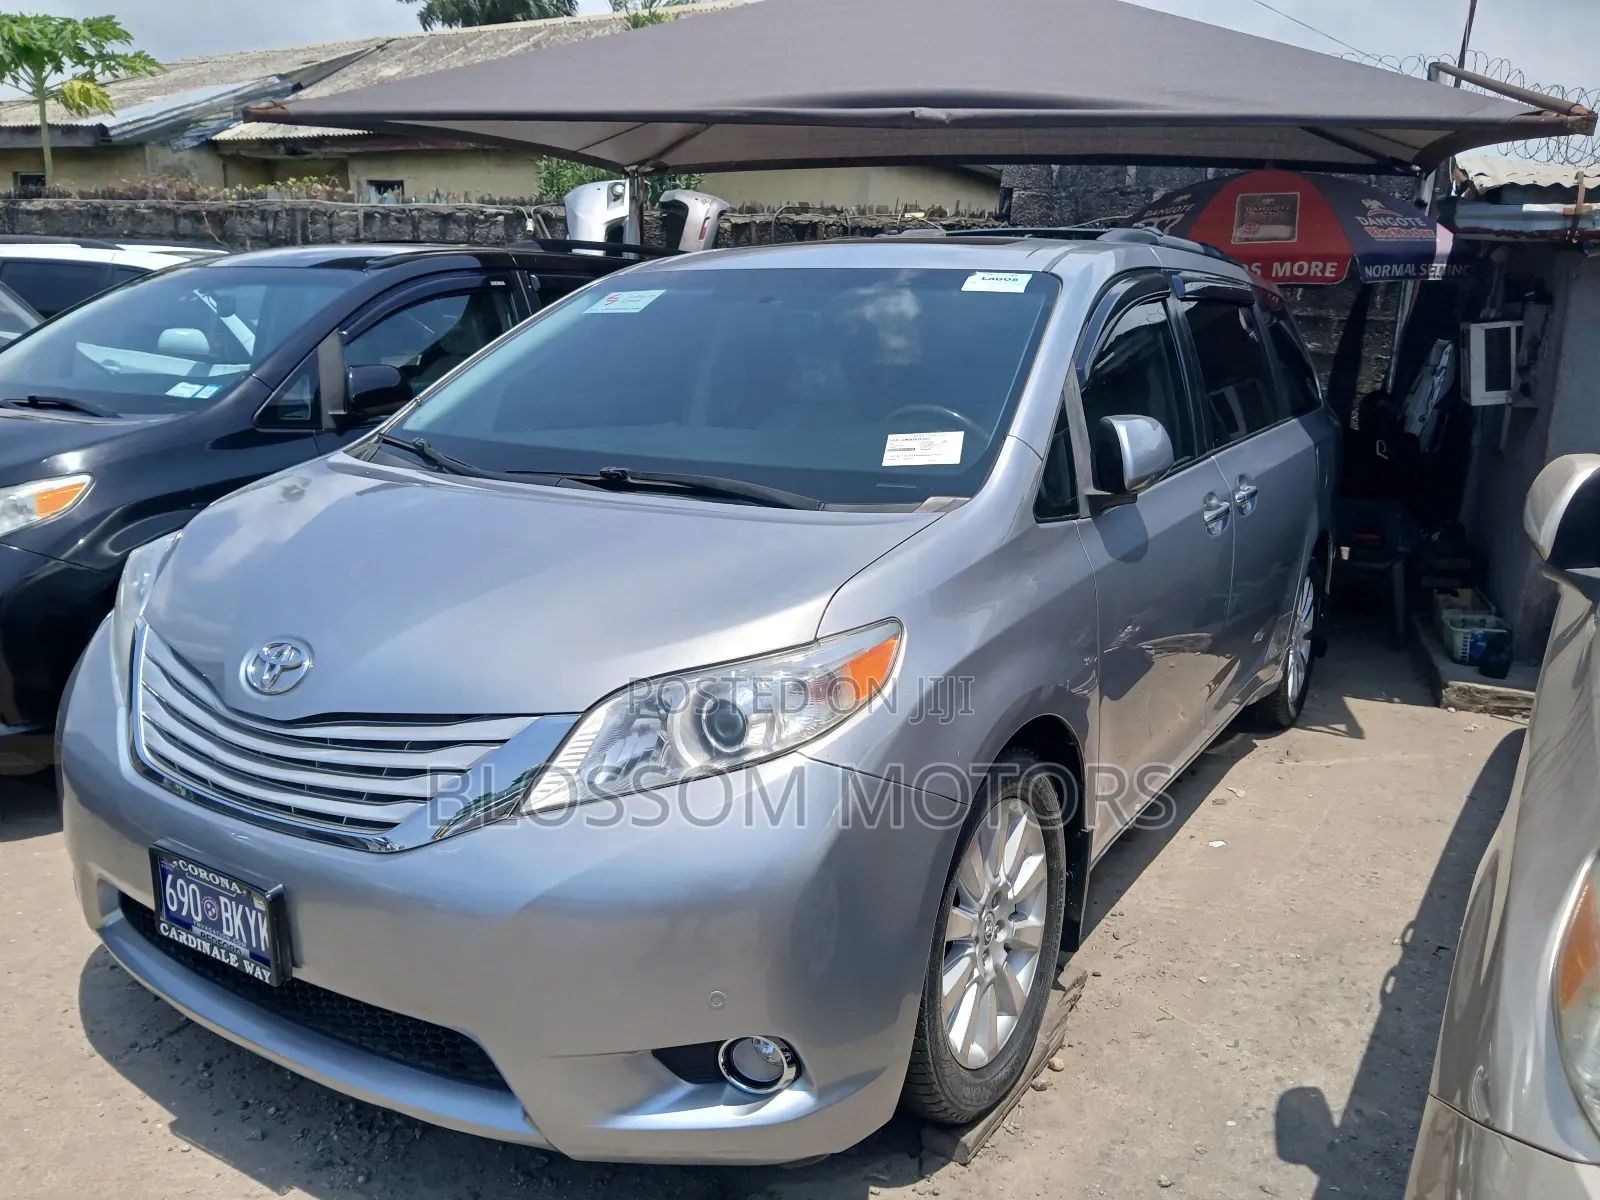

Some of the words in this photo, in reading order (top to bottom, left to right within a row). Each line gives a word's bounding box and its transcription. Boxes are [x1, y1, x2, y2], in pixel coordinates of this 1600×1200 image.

[1143, 203, 1195, 217] DANGOTE
[1355, 216, 1428, 227] DANGOTE
[1271, 261, 1338, 277] MORE
[1364, 263, 1416, 278] NORMAL
[178, 859, 243, 895] CORONA
[166, 874, 202, 922] 690
[220, 896, 270, 952] BKYK
[159, 924, 239, 968] CARDINALE
[243, 960, 271, 984] WAY
